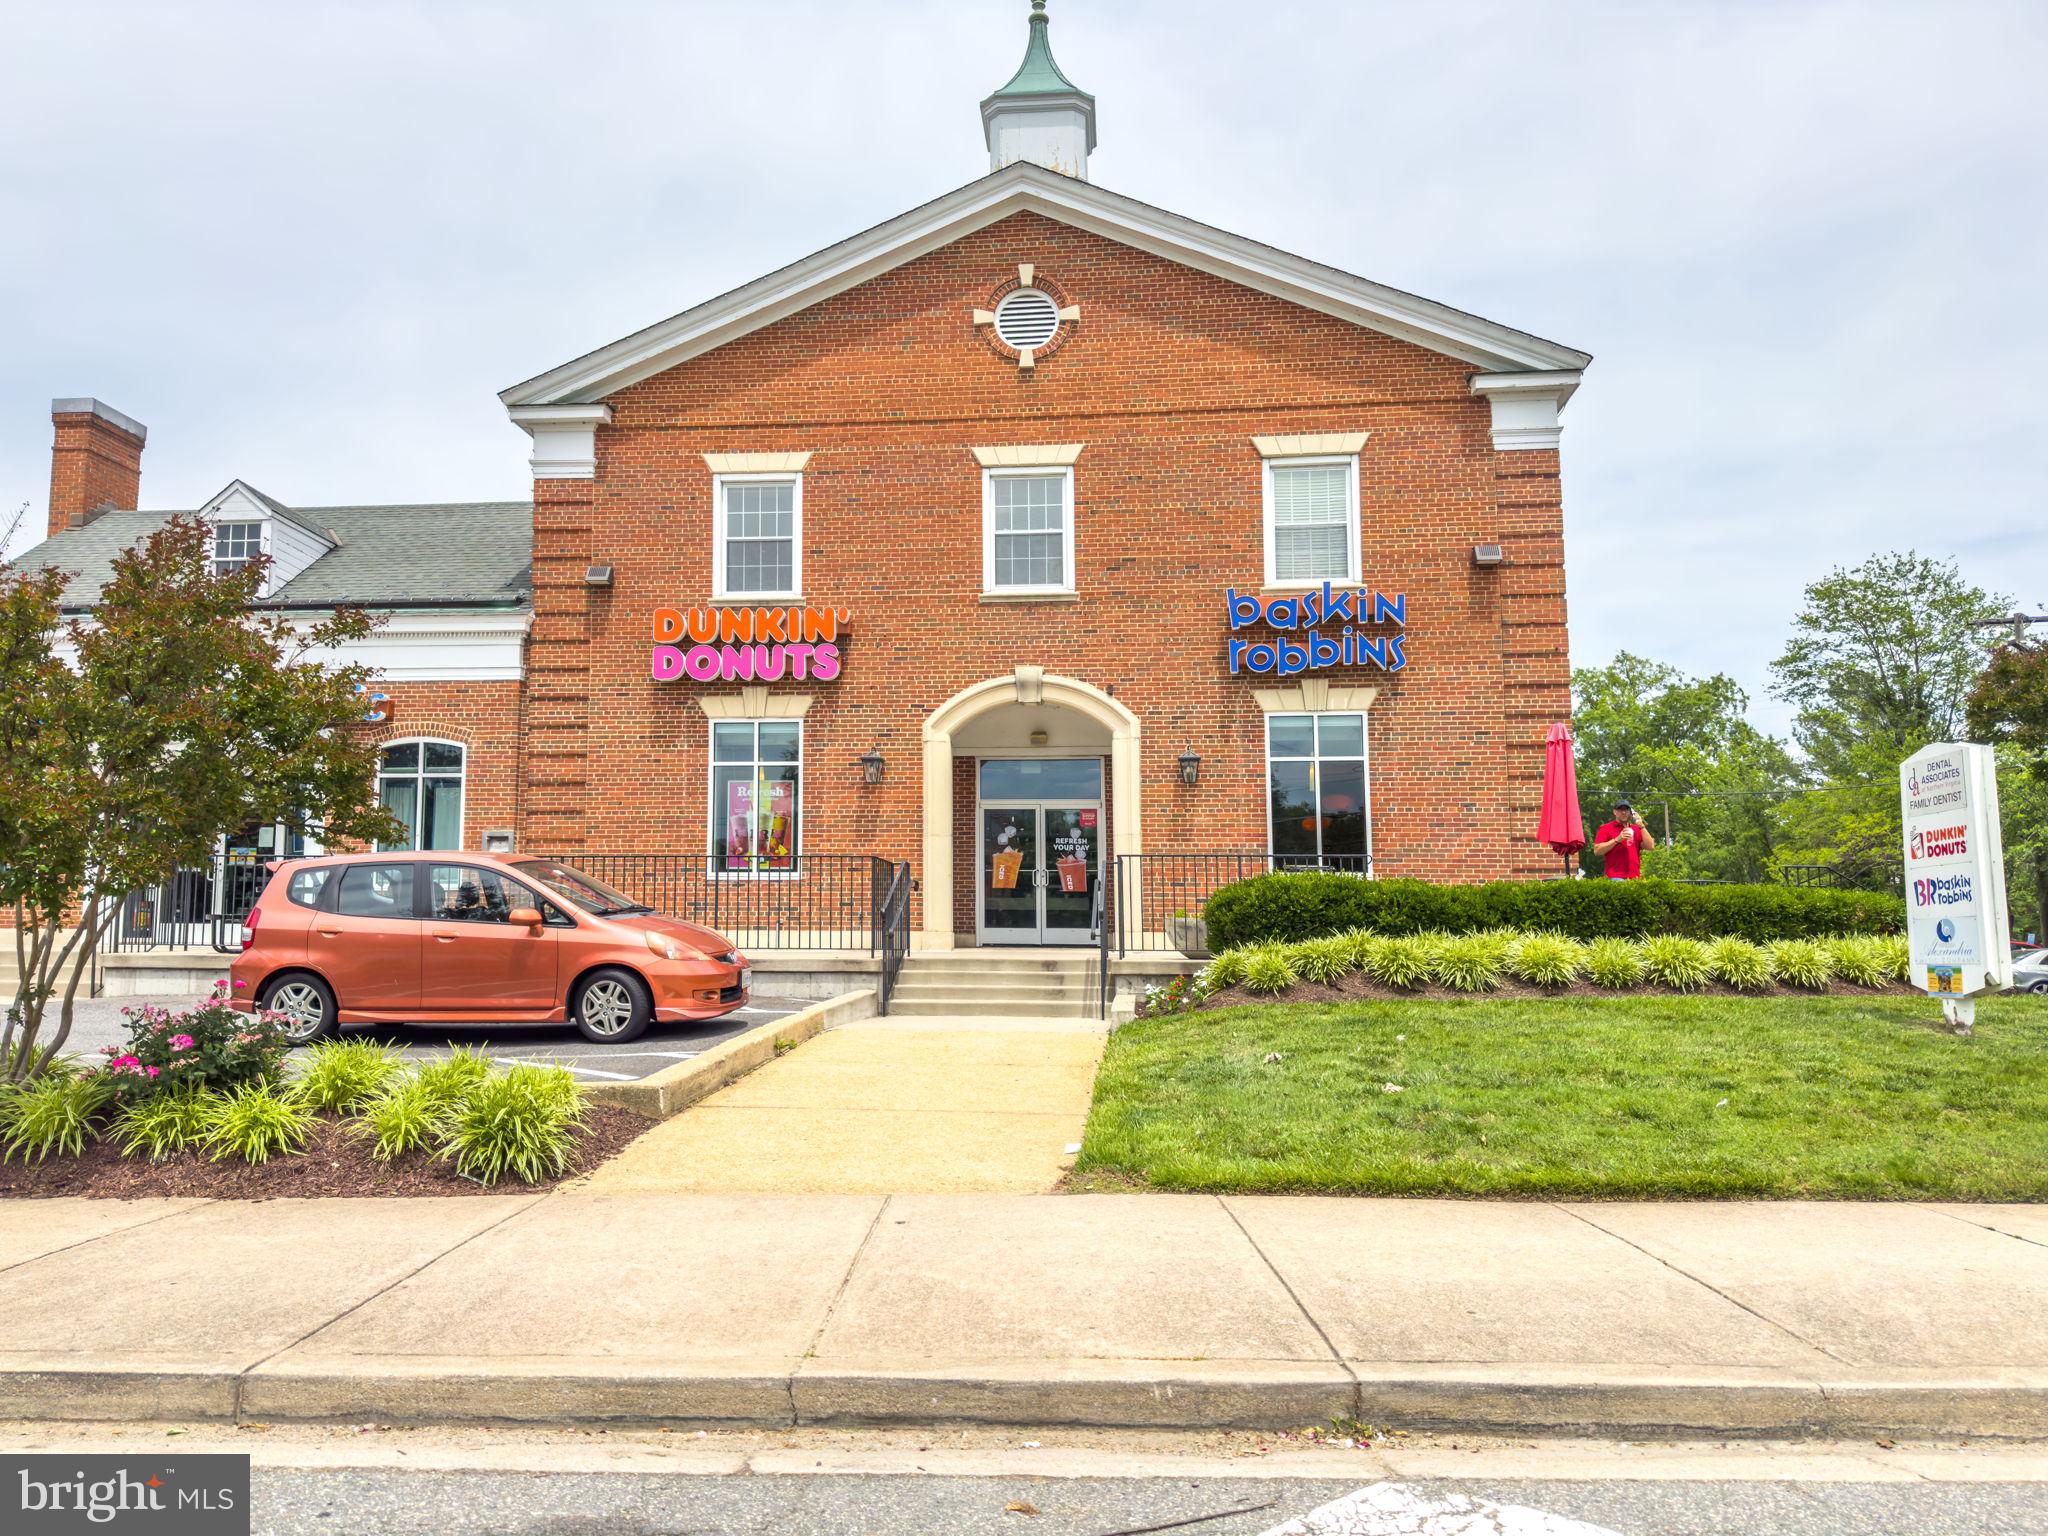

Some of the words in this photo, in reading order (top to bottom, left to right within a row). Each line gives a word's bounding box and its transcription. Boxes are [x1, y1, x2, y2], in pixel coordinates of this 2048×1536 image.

[653, 607, 850, 644] DUNKIN'
[652, 644, 842, 682] DONUTS
[1927, 759, 1952, 772] DENTAL
[1921, 768, 1960, 784] ASSOCIATES
[737, 786, 784, 797] Reesh
[1909, 798, 1931, 810] FAMILY
[1932, 790, 1962, 806] DENTIST
[1926, 825, 1967, 843] DUNKIN'
[1927, 841, 1967, 858] DONUTS
